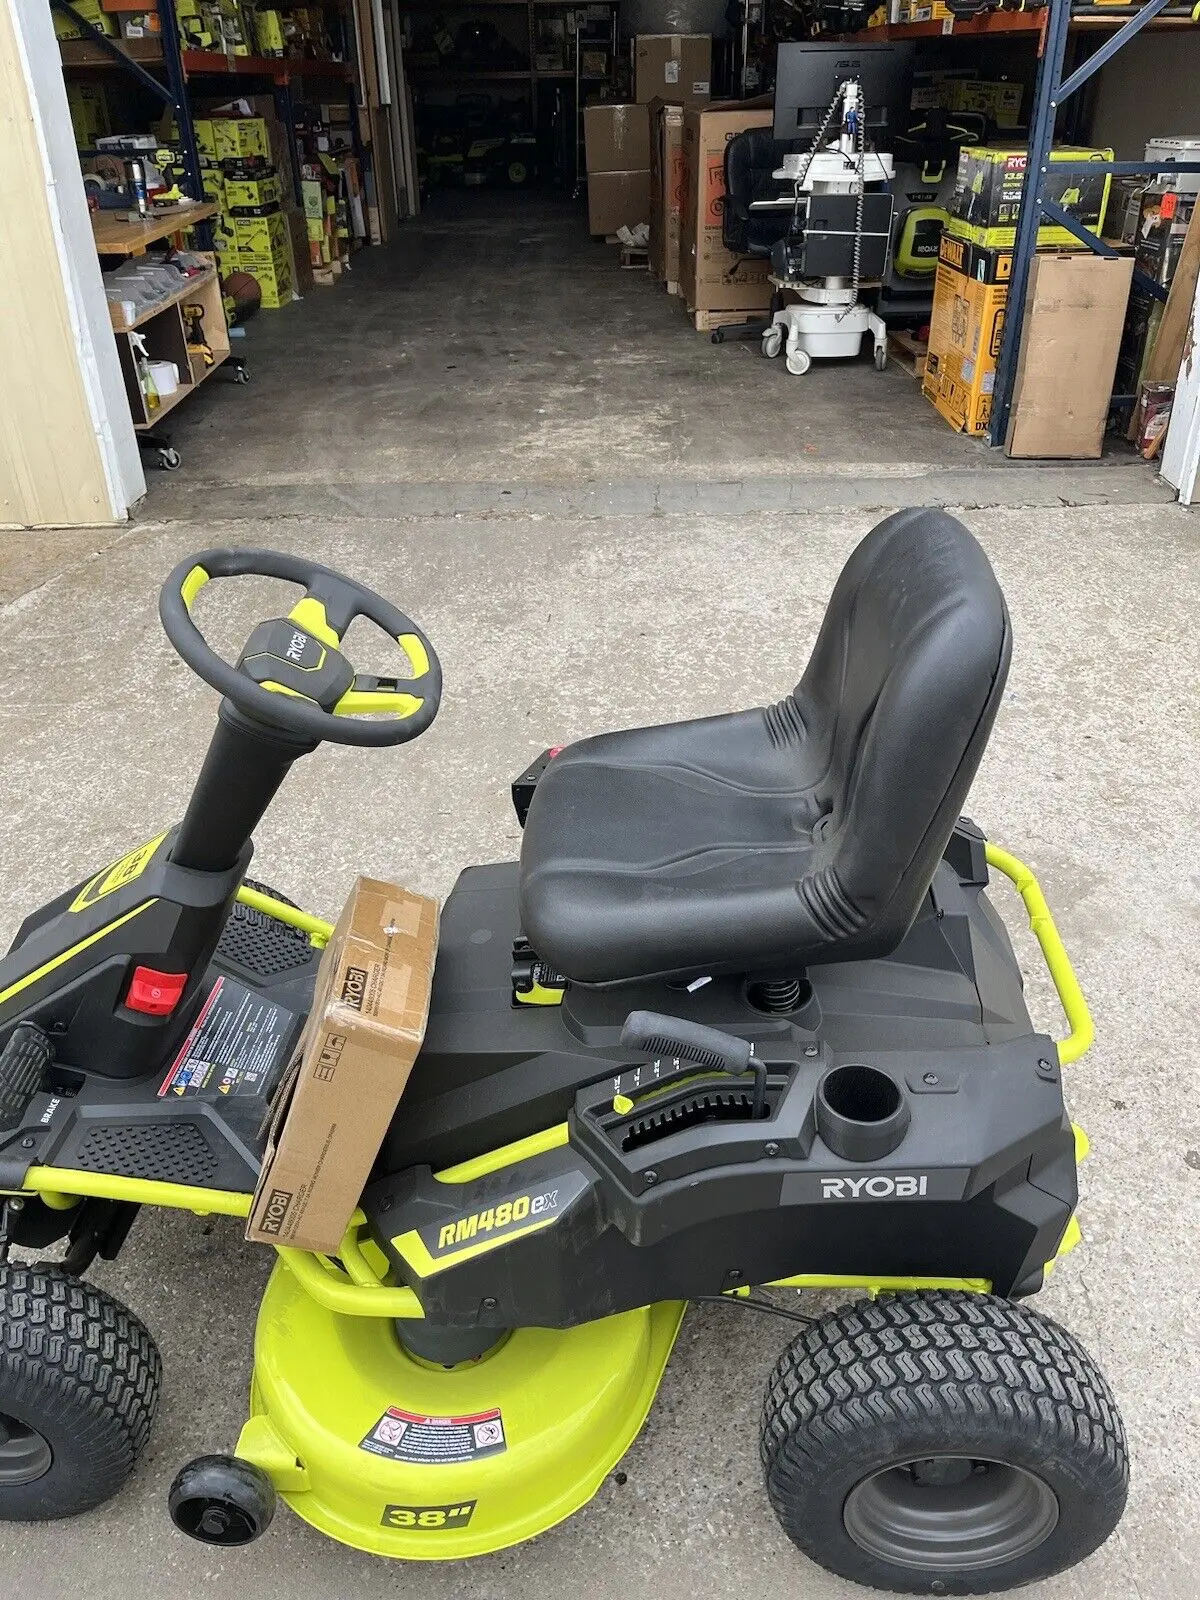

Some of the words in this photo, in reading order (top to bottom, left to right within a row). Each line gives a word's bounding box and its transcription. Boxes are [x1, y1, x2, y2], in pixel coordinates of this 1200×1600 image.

[834, 60, 861, 68] ASUS
[1007, 157, 1027, 168] RYO
[286, 631, 308, 661] RYOBI
[345, 968, 366, 1010] RYOBI
[40, 1098, 60, 1124] BRAKE
[820, 1175, 928, 1199] RYOBI
[262, 1191, 291, 1233] RYOBI
